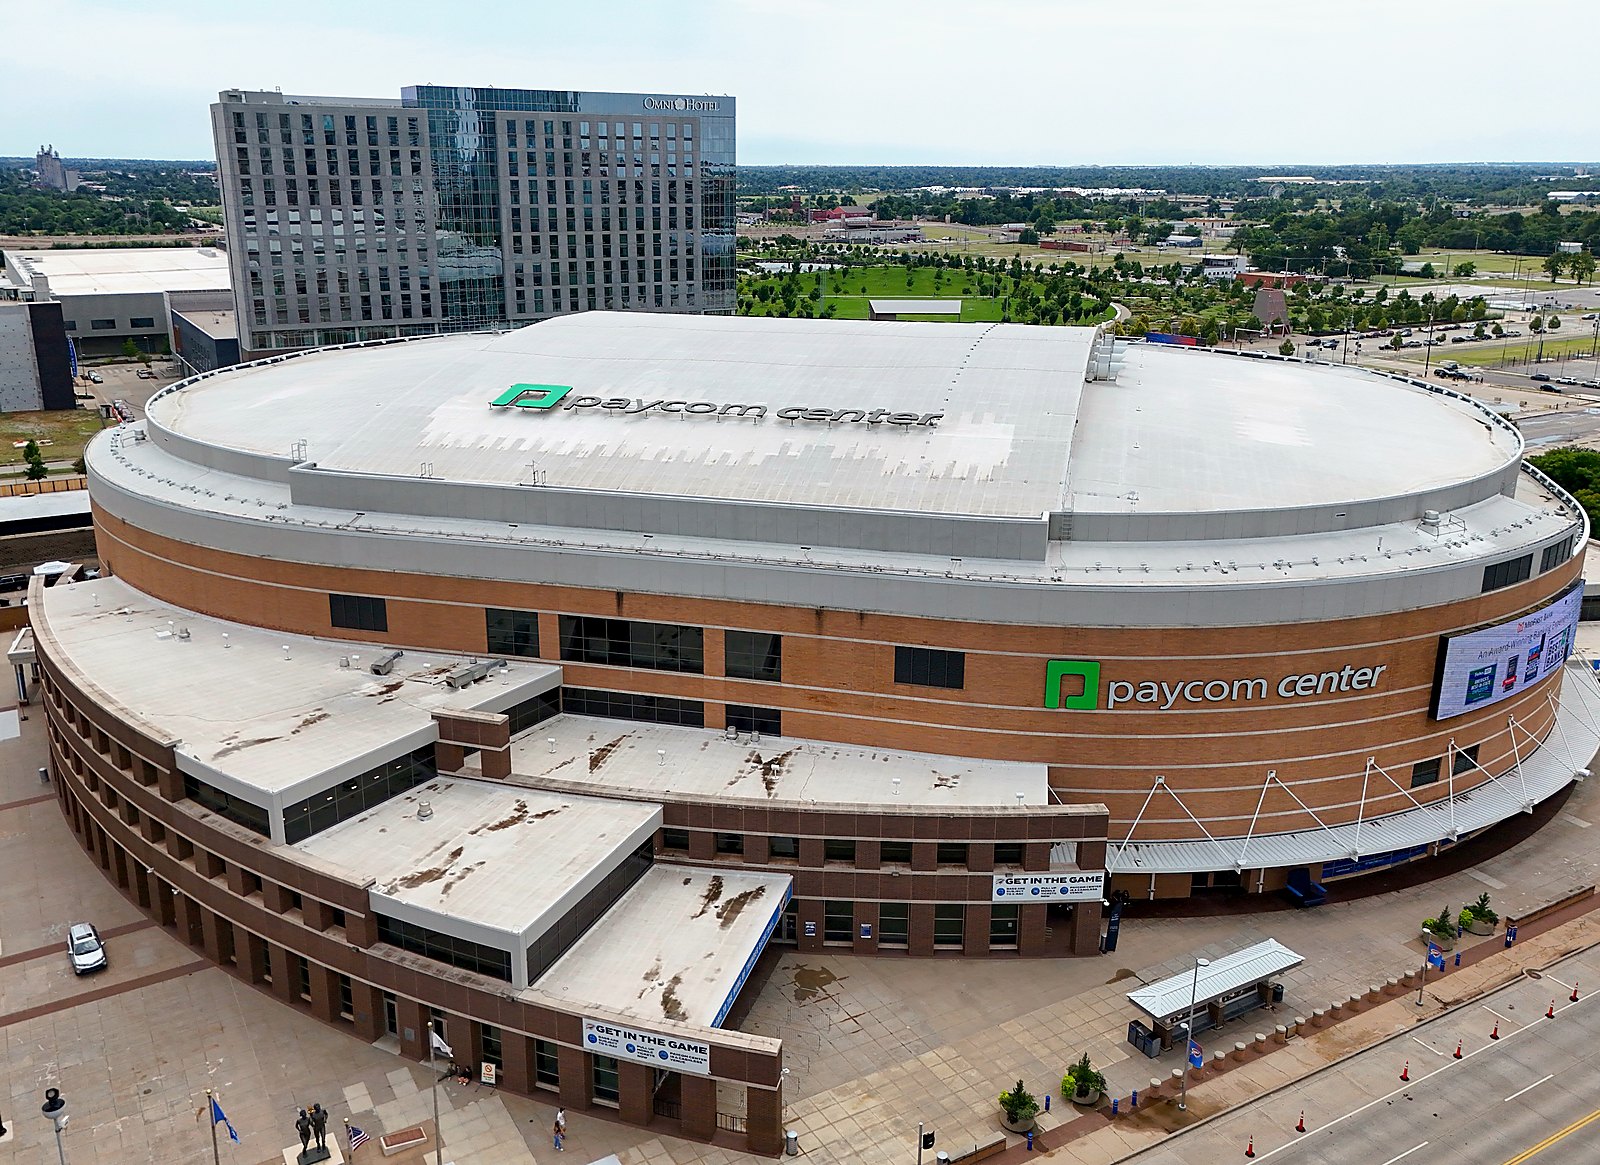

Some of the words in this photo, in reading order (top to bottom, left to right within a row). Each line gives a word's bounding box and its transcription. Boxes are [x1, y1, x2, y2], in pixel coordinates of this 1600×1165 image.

[643, 96, 674, 110] OMNI
[686, 97, 720, 111] HOTEL
[564, 393, 768, 418] paycom
[776, 403, 944, 427] center
[1107, 678, 1268, 710] paycom
[1278, 663, 1387, 699] center
[1005, 877, 1029, 885] GET
[1044, 876, 1067, 884] THE
[1069, 875, 1103, 884] GAME
[596, 1025, 621, 1037] GET
[623, 1030, 637, 1041] IN
[639, 1034, 666, 1047] THE
[668, 1040, 708, 1055] GAME
